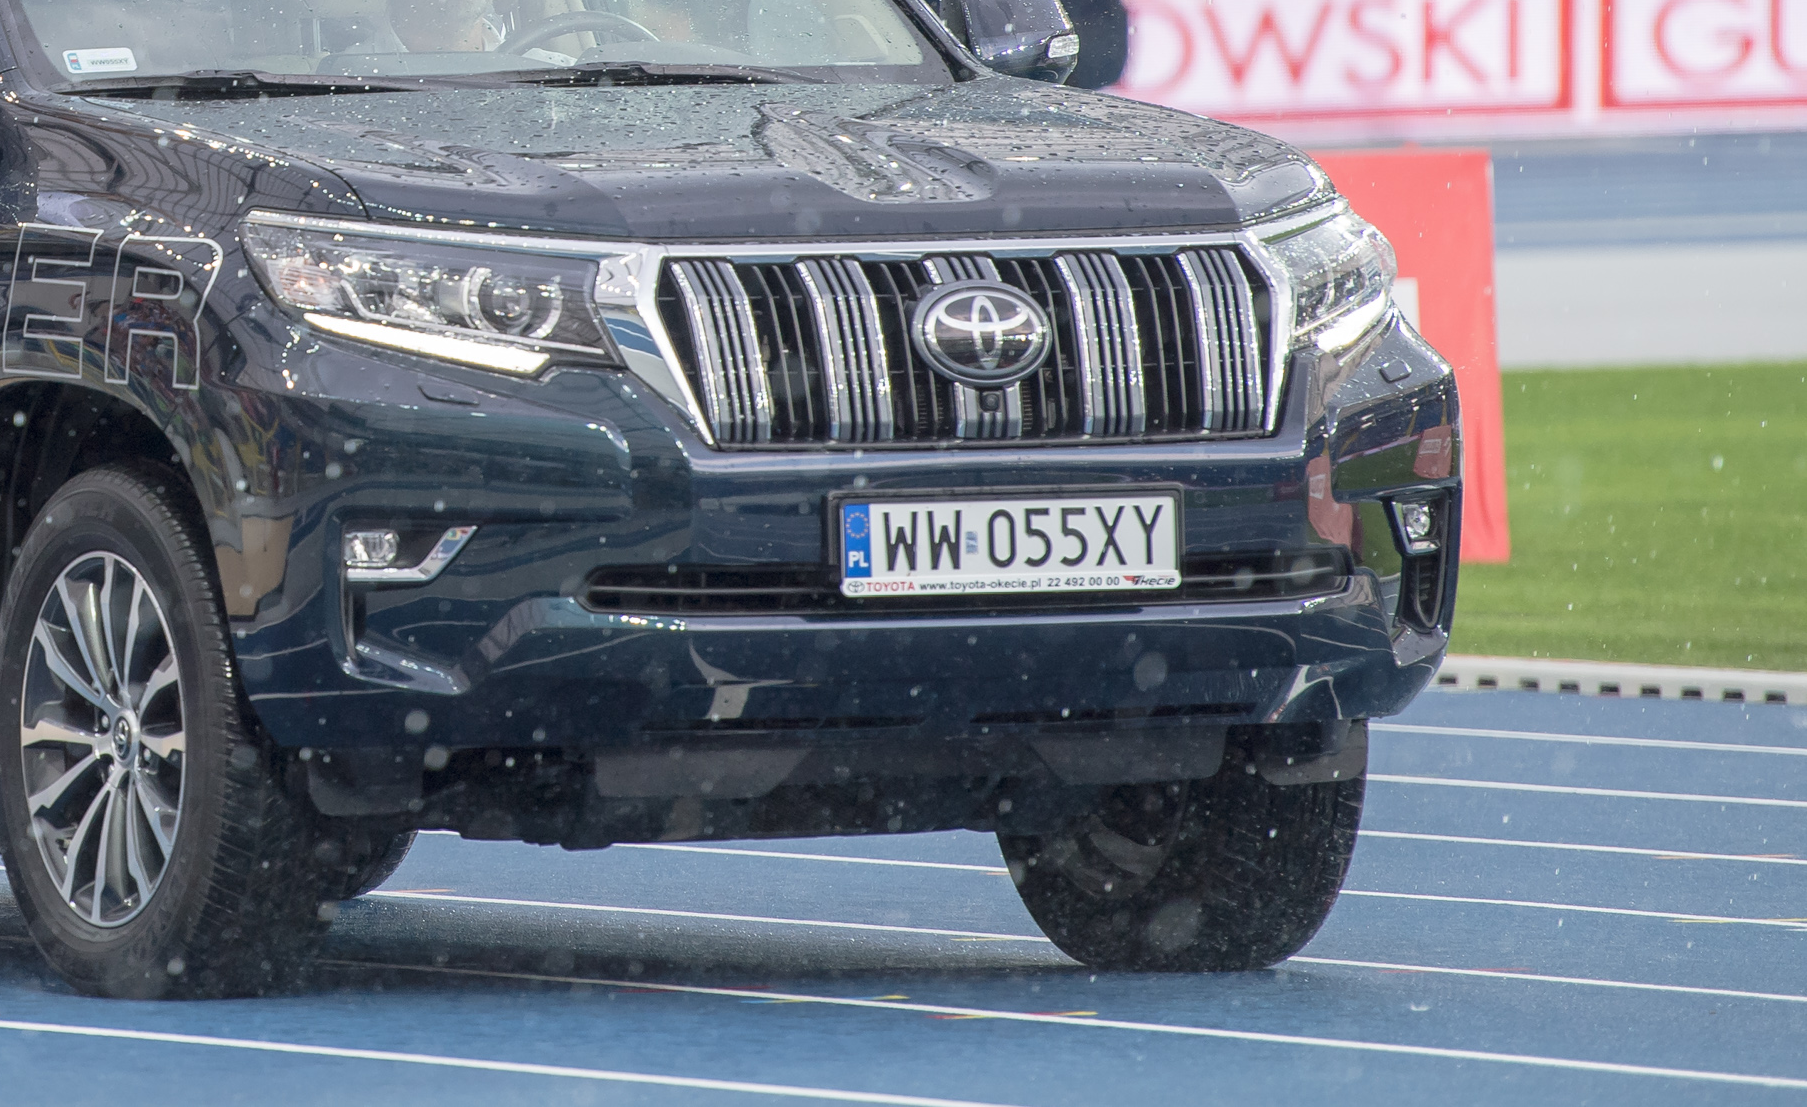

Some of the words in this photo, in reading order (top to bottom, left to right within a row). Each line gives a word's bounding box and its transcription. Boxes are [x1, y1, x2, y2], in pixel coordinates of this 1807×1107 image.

[882, 509, 963, 572] WW
[987, 504, 1164, 569] 055XY
[848, 550, 869, 568] PL
[866, 581, 916, 592] TOYOTA
[919, 578, 1042, 592] www.toyota-okecie.pl
[1047, 577, 1061, 587] 22
[1065, 577, 1085, 587] 492
[1088, 576, 1103, 586] 00
[1106, 576, 1120, 586] 00
